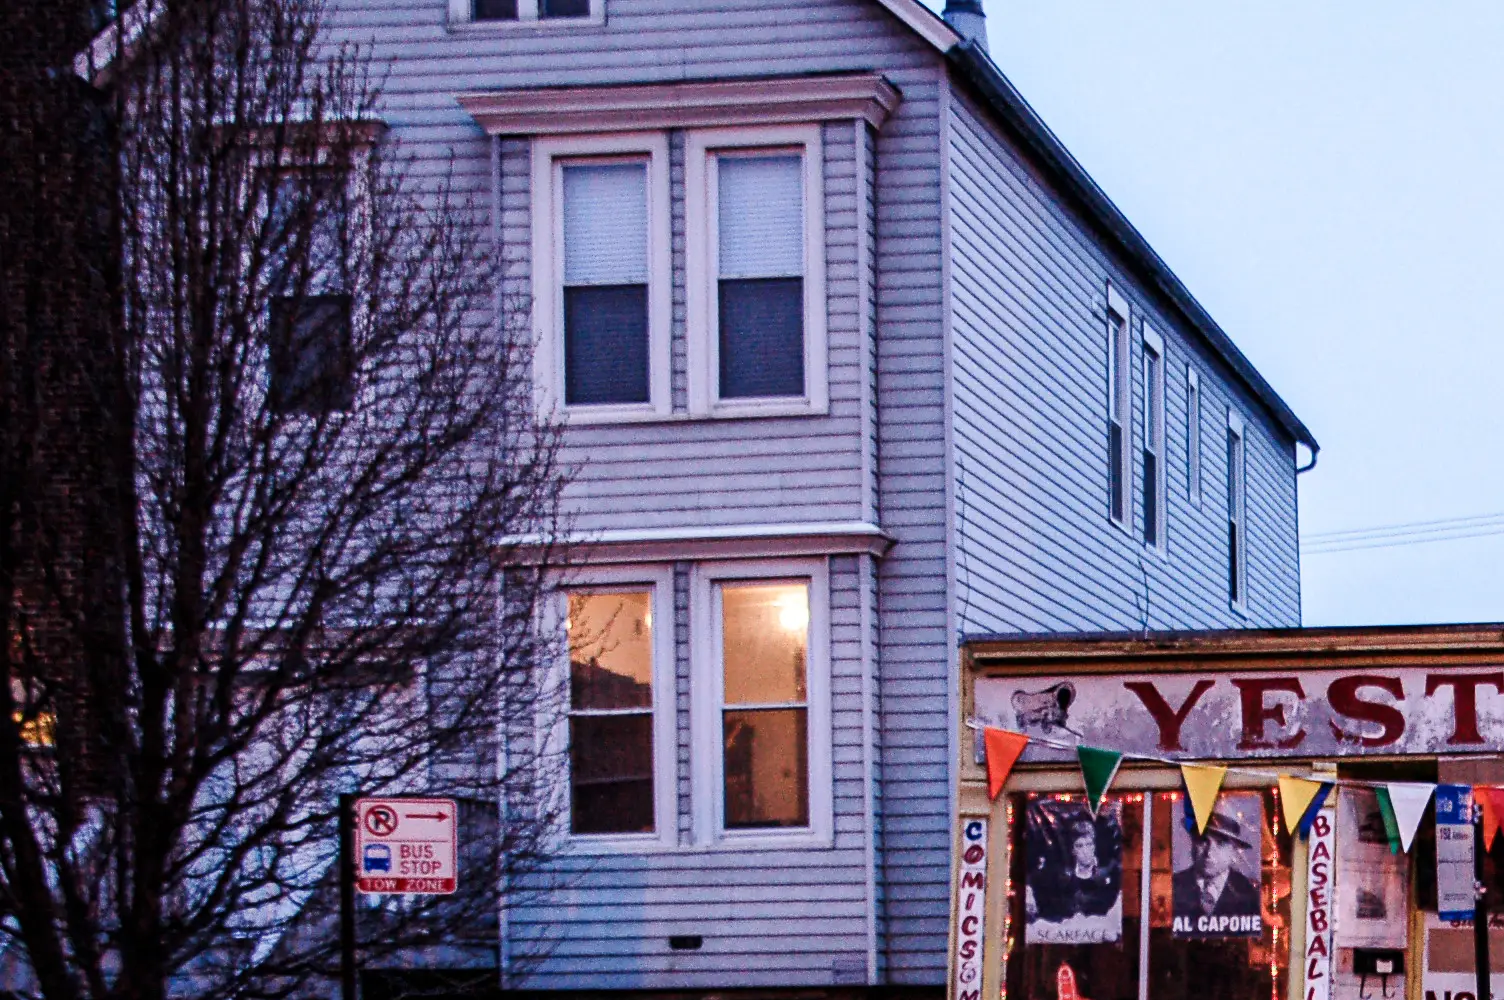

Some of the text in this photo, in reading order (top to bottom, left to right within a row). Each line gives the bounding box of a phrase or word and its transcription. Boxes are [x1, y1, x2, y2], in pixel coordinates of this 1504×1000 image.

[400, 843, 434, 859] BUS
[400, 860, 442, 875] STOP
[367, 879, 446, 892] TOW ZONE
[960, 821, 985, 960] COMICS
[1172, 915, 1262, 932] AL CAPONE
